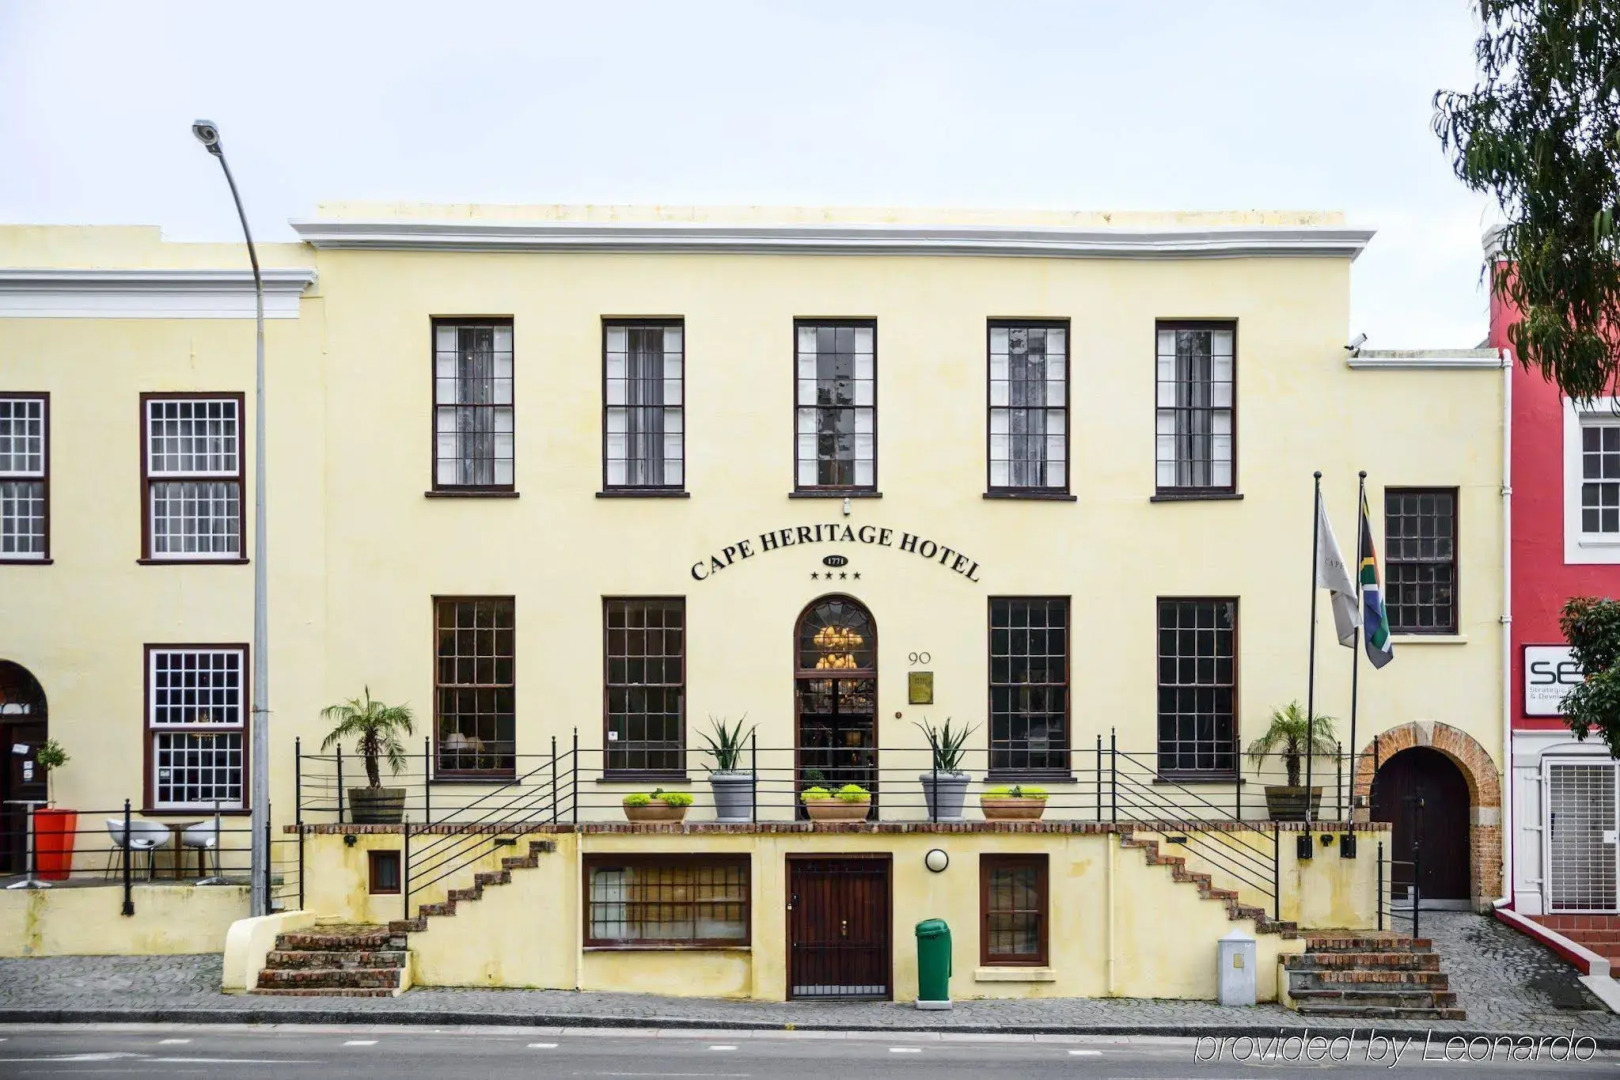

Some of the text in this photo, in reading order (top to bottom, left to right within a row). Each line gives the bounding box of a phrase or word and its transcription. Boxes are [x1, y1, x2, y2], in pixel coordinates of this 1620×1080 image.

[690, 523, 980, 583] CAPE HERITAGE HOTEL
[828, 557, 844, 565] 1771
[908, 651, 931, 666] 90
